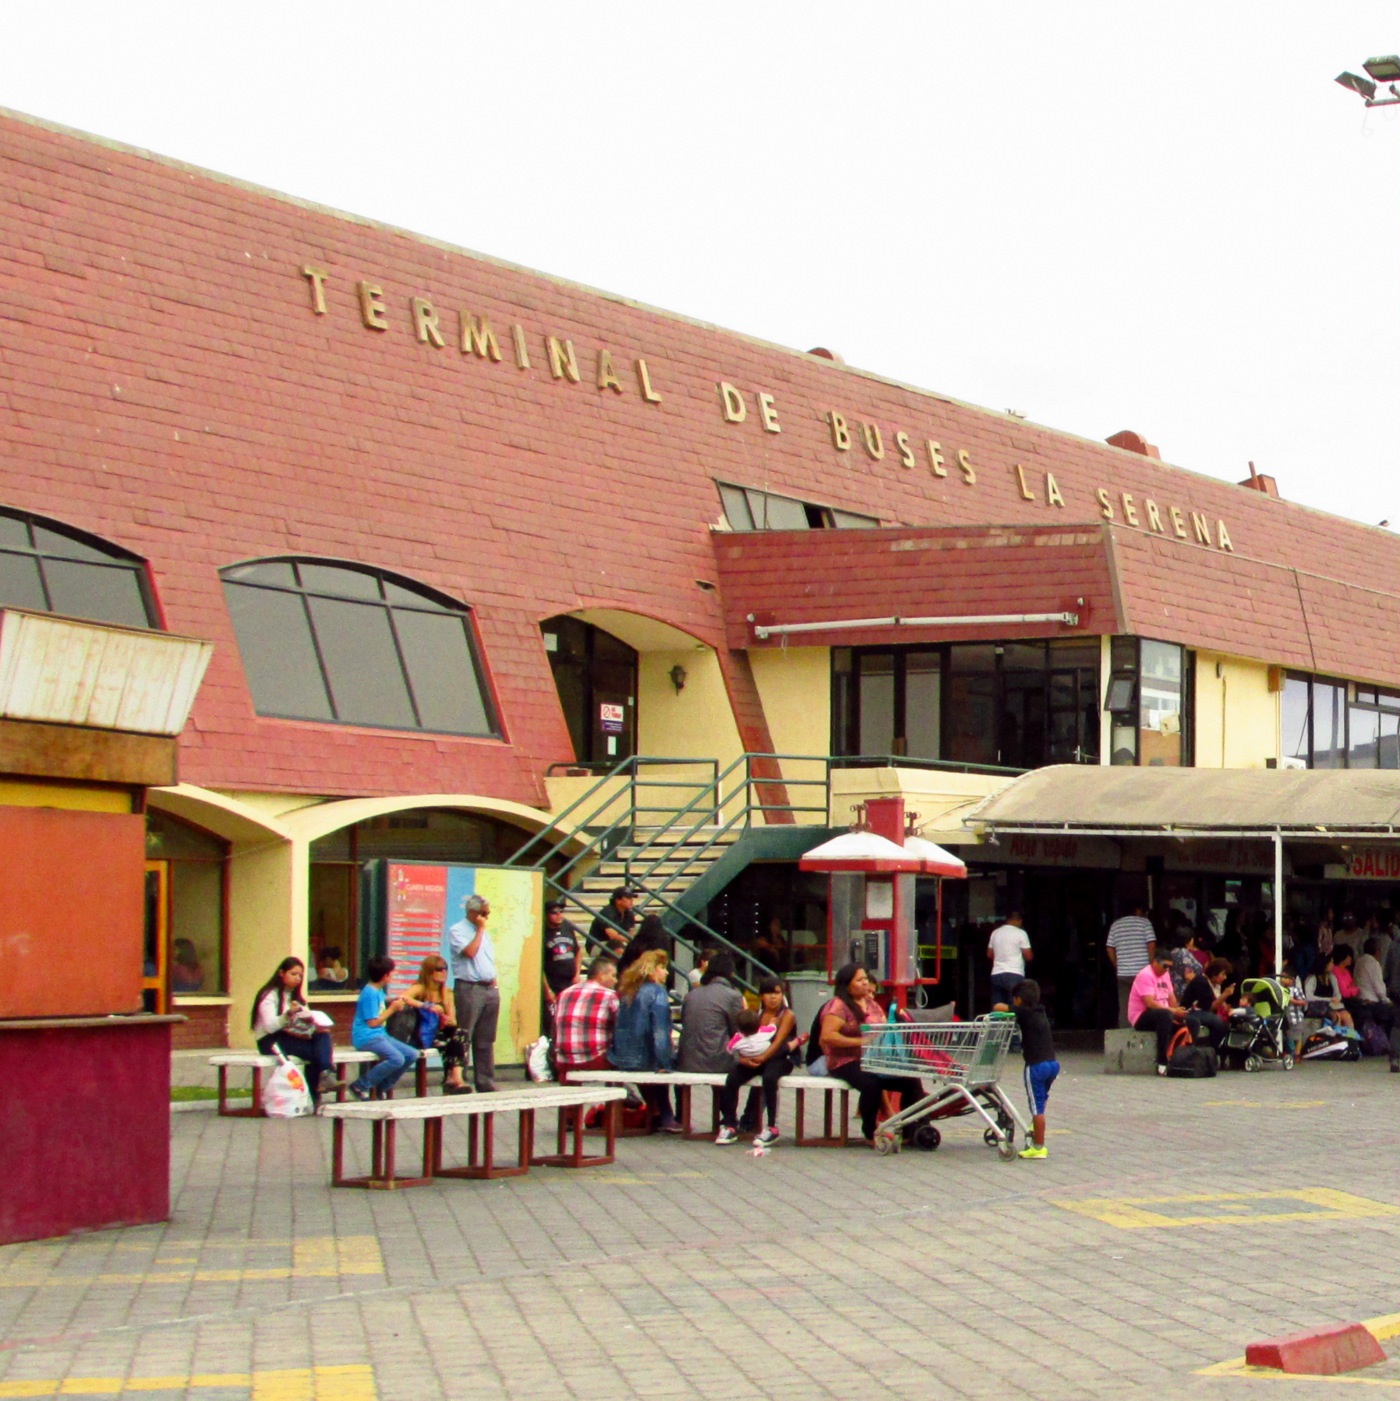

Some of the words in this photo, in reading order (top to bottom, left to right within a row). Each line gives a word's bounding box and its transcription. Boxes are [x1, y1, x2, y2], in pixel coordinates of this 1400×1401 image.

[304, 265, 663, 404] TERMINAL
[717, 381, 782, 434] DE
[827, 410, 977, 485] BUSES
[1016, 463, 1065, 508] LA
[1096, 487, 1234, 553] SERENA
